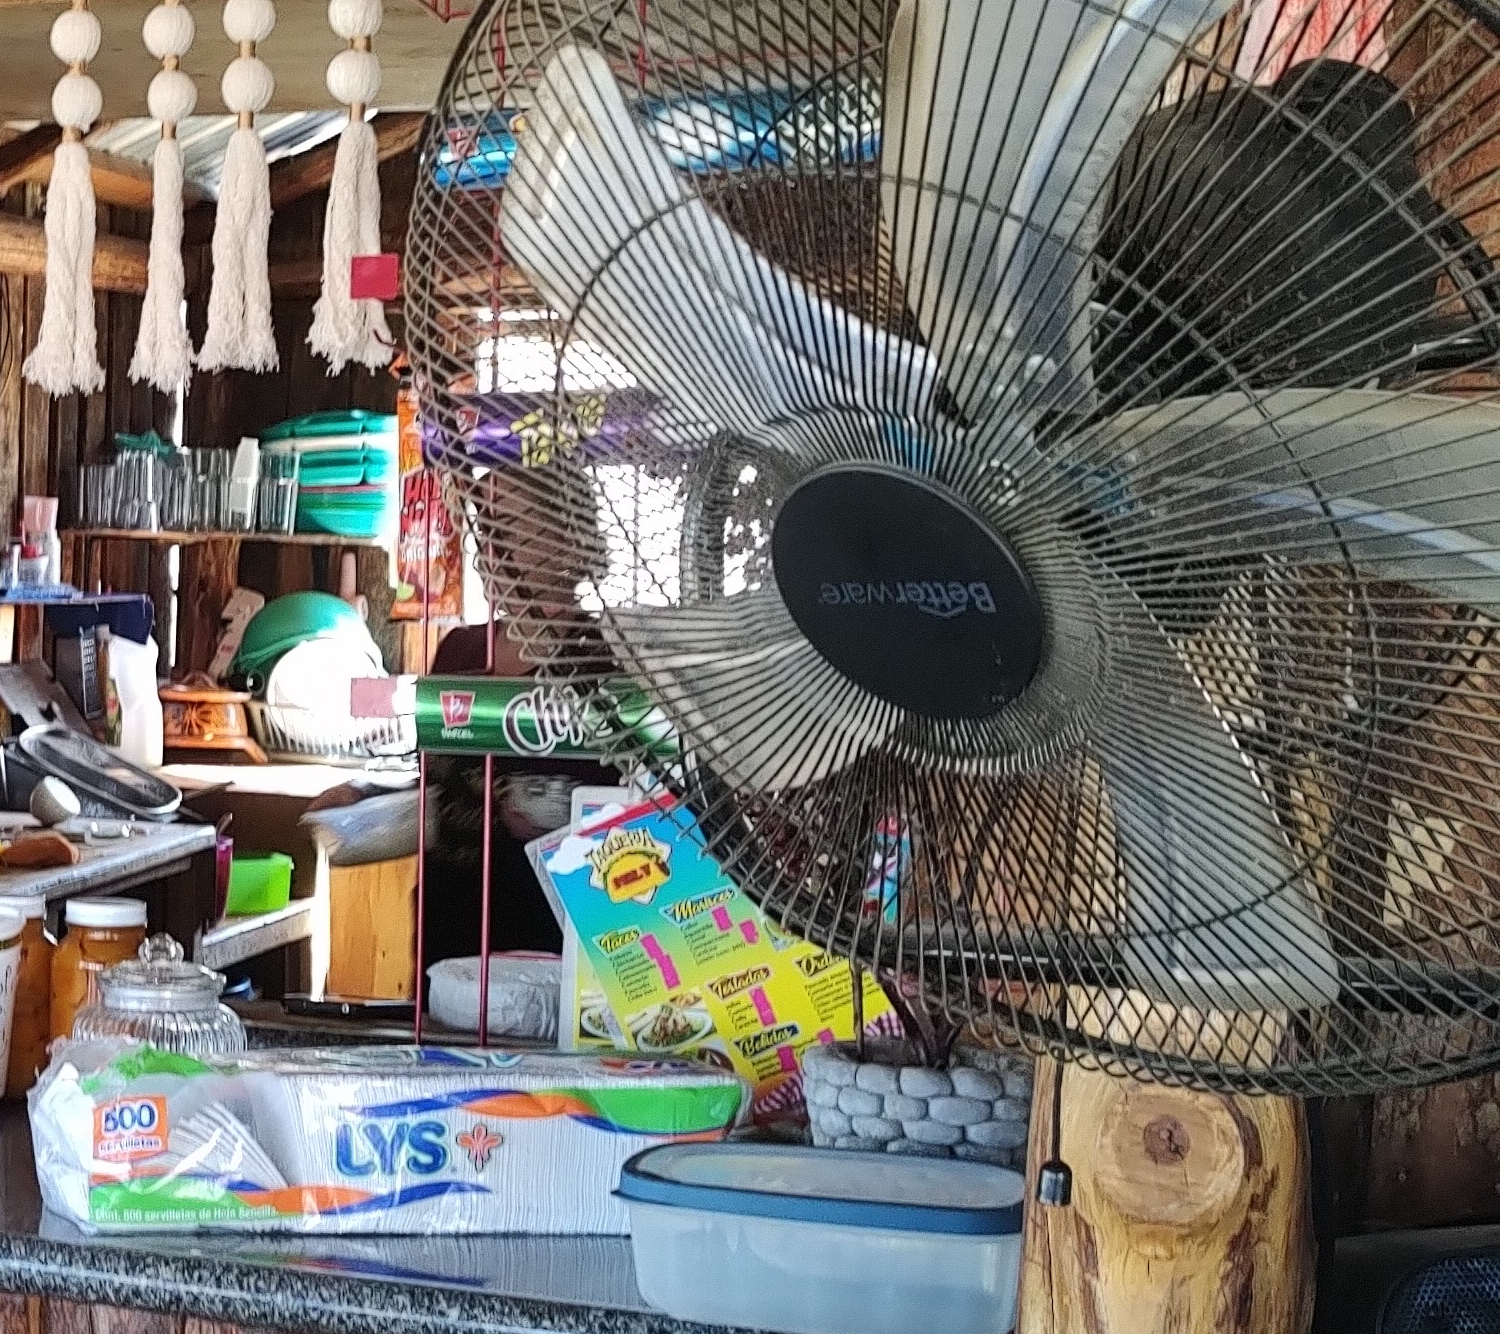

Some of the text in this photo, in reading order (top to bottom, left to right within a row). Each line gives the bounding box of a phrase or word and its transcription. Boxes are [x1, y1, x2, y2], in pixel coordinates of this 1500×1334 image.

[818, 579, 998, 615] Betterware
[103, 1103, 157, 1134] 500
[336, 1120, 448, 1177] LYS
